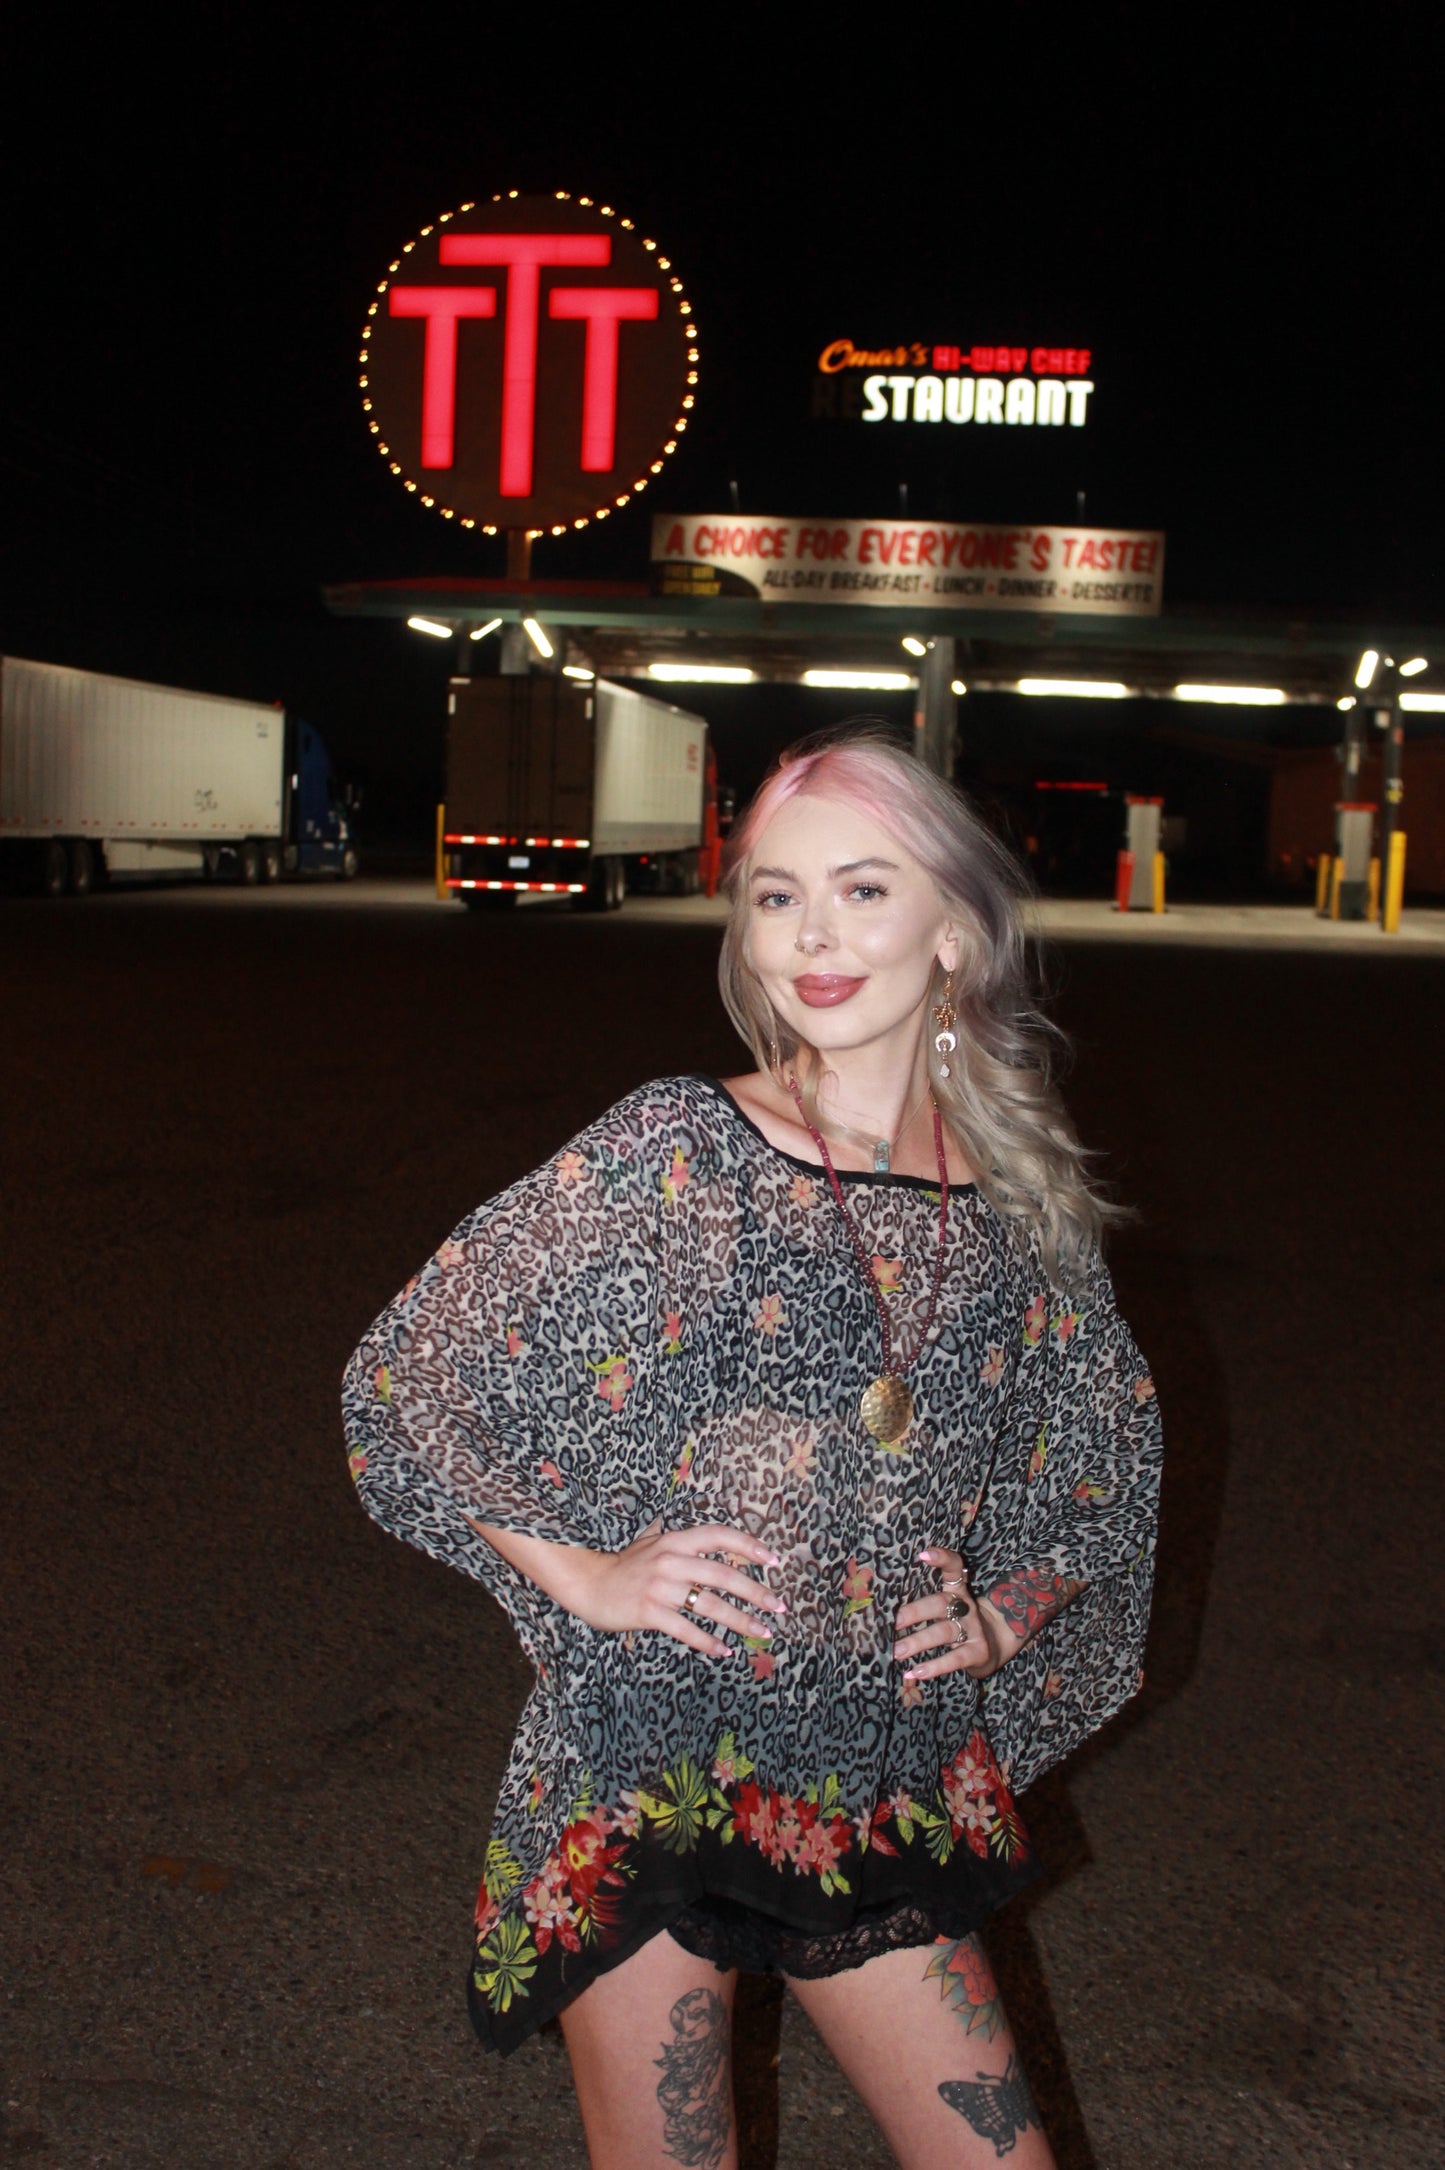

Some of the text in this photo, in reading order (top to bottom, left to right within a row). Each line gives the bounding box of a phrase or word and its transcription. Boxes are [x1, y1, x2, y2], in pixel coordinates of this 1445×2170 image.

[388, 233, 660, 498] TTT
[818, 338, 1093, 375] Omar's HI-WAY CHEF
[666, 523, 1158, 575] A CHOICE FOR EVERYONE'S TASTE!
[830, 571, 922, 593] BREAKFAST
[933, 575, 986, 595] LUNCH
[999, 578, 1057, 599] DINNER
[1071, 581, 1154, 603] DESSERTS
